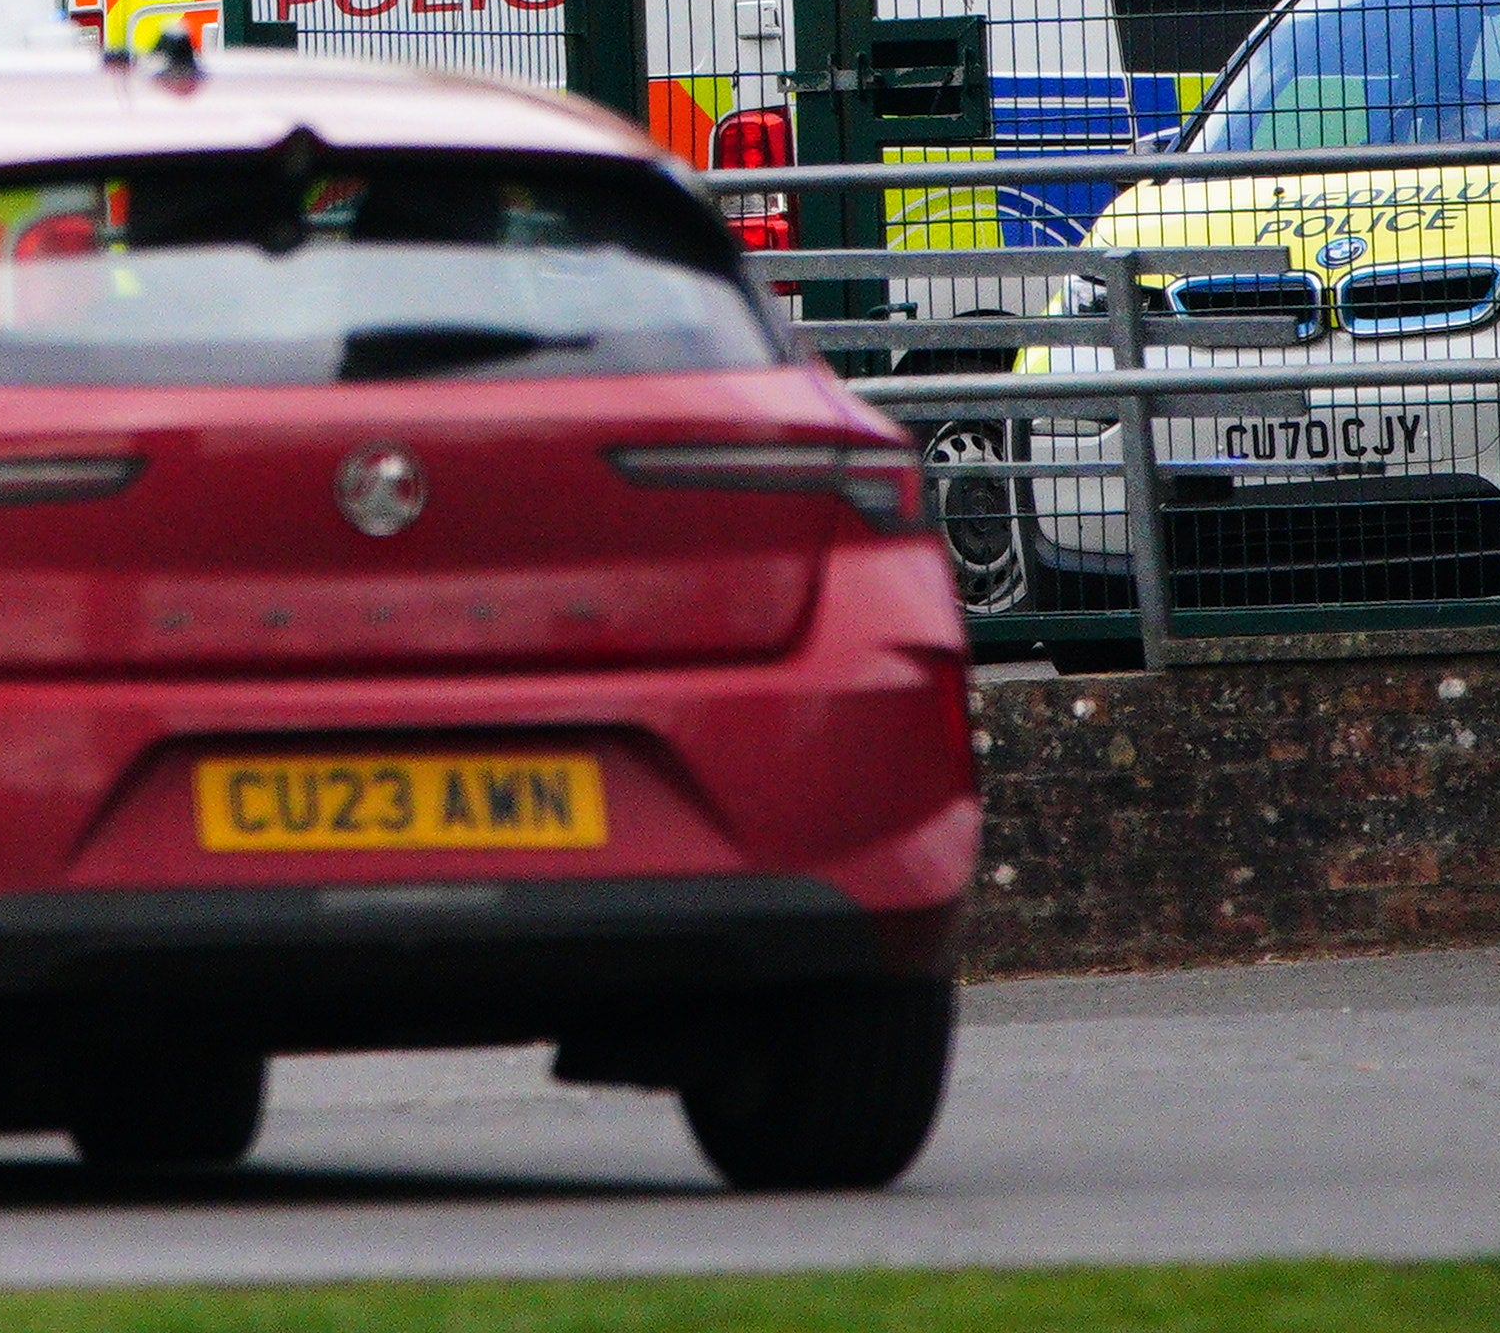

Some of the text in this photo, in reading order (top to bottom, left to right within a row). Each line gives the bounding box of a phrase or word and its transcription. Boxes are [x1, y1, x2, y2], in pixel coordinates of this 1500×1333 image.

[1267, 182, 1498, 213] HEDDLU
[1254, 207, 1468, 244] POLICE
[1341, 414, 1421, 458] CJY
[227, 769, 574, 833] CU23 AWN
